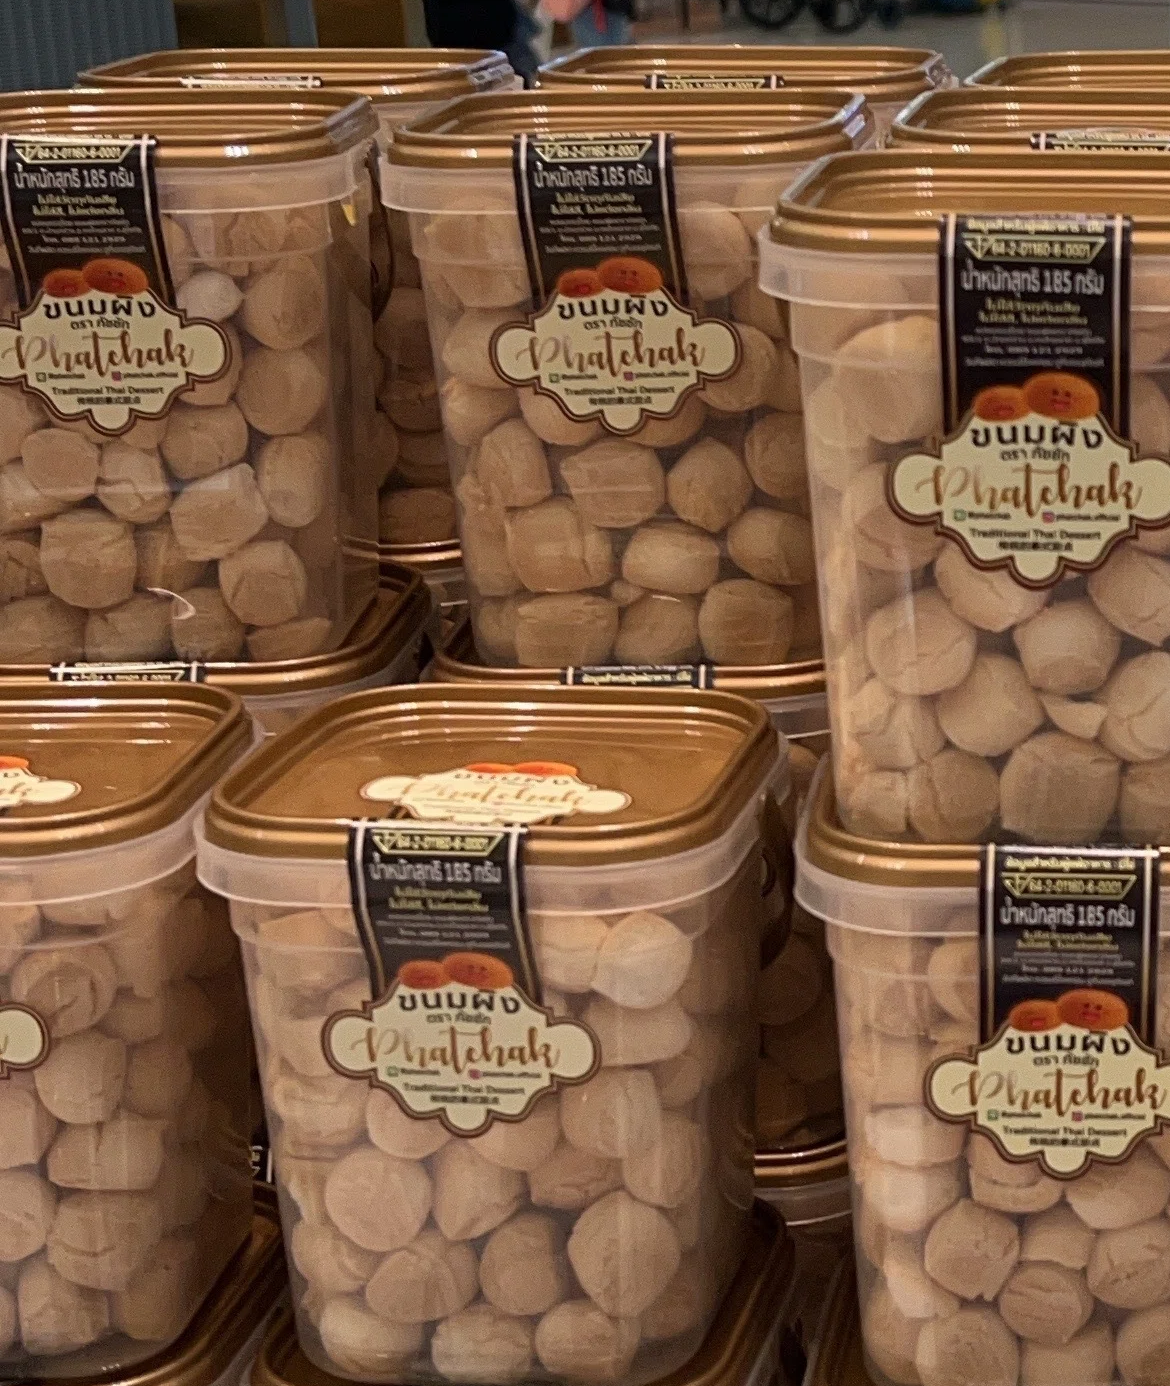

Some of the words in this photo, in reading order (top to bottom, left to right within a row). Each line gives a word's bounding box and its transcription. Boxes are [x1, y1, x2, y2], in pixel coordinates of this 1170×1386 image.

[83, 168, 107, 187] 185
[601, 166, 626, 186] 185
[1043, 269, 1072, 294] 185
[43, 296, 155, 319] ขนมผิง
[557, 294, 669, 320] ขนมผิง
[1, 328, 194, 377] Phatchak
[515, 327, 705, 377] Phatchak
[971, 421, 1102, 448] ขนมผิง
[915, 463, 1142, 517] Phatchak
[969, 528, 1031, 538] Traditional
[1033, 529, 1057, 538] Thai
[444, 863, 471, 882] 185
[1078, 906, 1105, 927] 185
[399, 990, 520, 1013] ขนมผิง
[351, 1026, 560, 1074] Phatchak
[1006, 1032, 1130, 1055] ขนมผิง
[404, 1084, 459, 1093] Traditional
[952, 1068, 1167, 1116] Phatchak
[1004, 1125, 1060, 1134] Traditional
[1063, 1126, 1085, 1134] Thai
